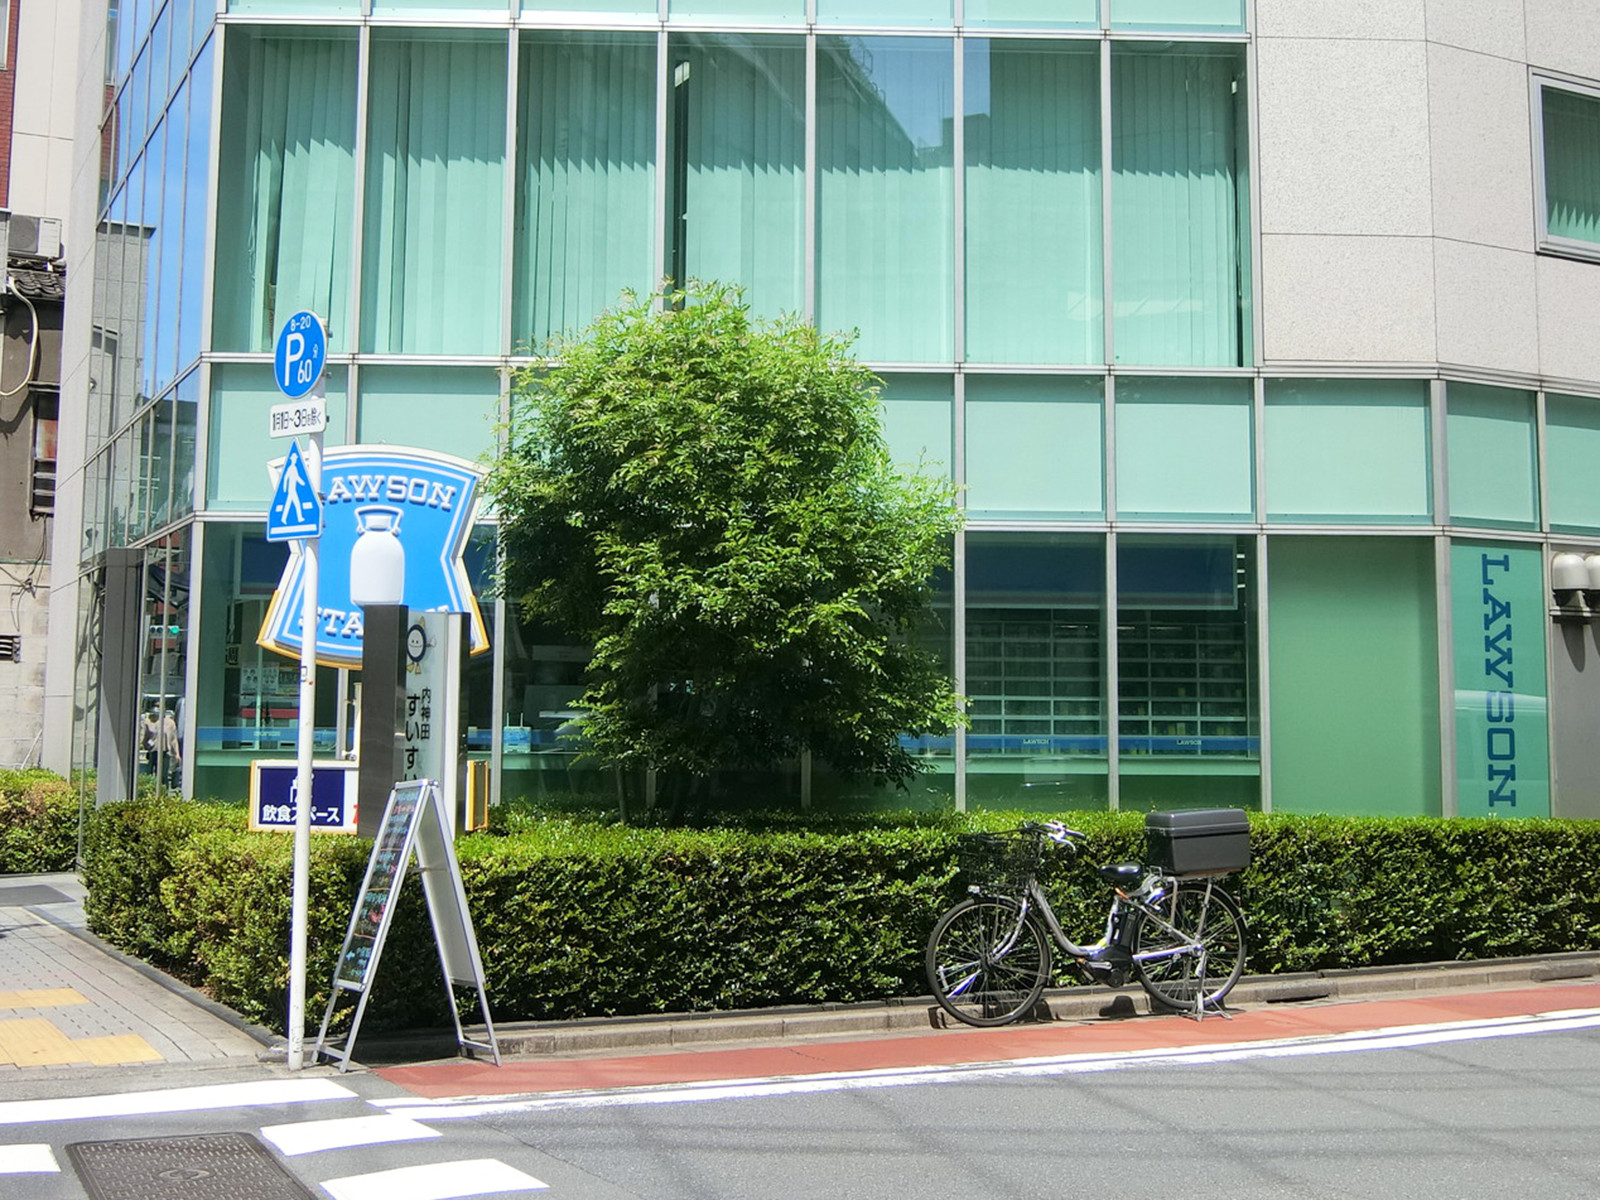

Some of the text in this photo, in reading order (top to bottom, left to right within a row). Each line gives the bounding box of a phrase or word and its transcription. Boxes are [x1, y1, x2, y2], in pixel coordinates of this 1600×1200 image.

[290, 315, 311, 331] 8-20
[285, 332, 305, 387] P
[297, 359, 312, 384] 60
[327, 475, 457, 511] AWSON
[1481, 553, 1517, 807] LAWSON
[420, 687, 431, 740] 内神田
